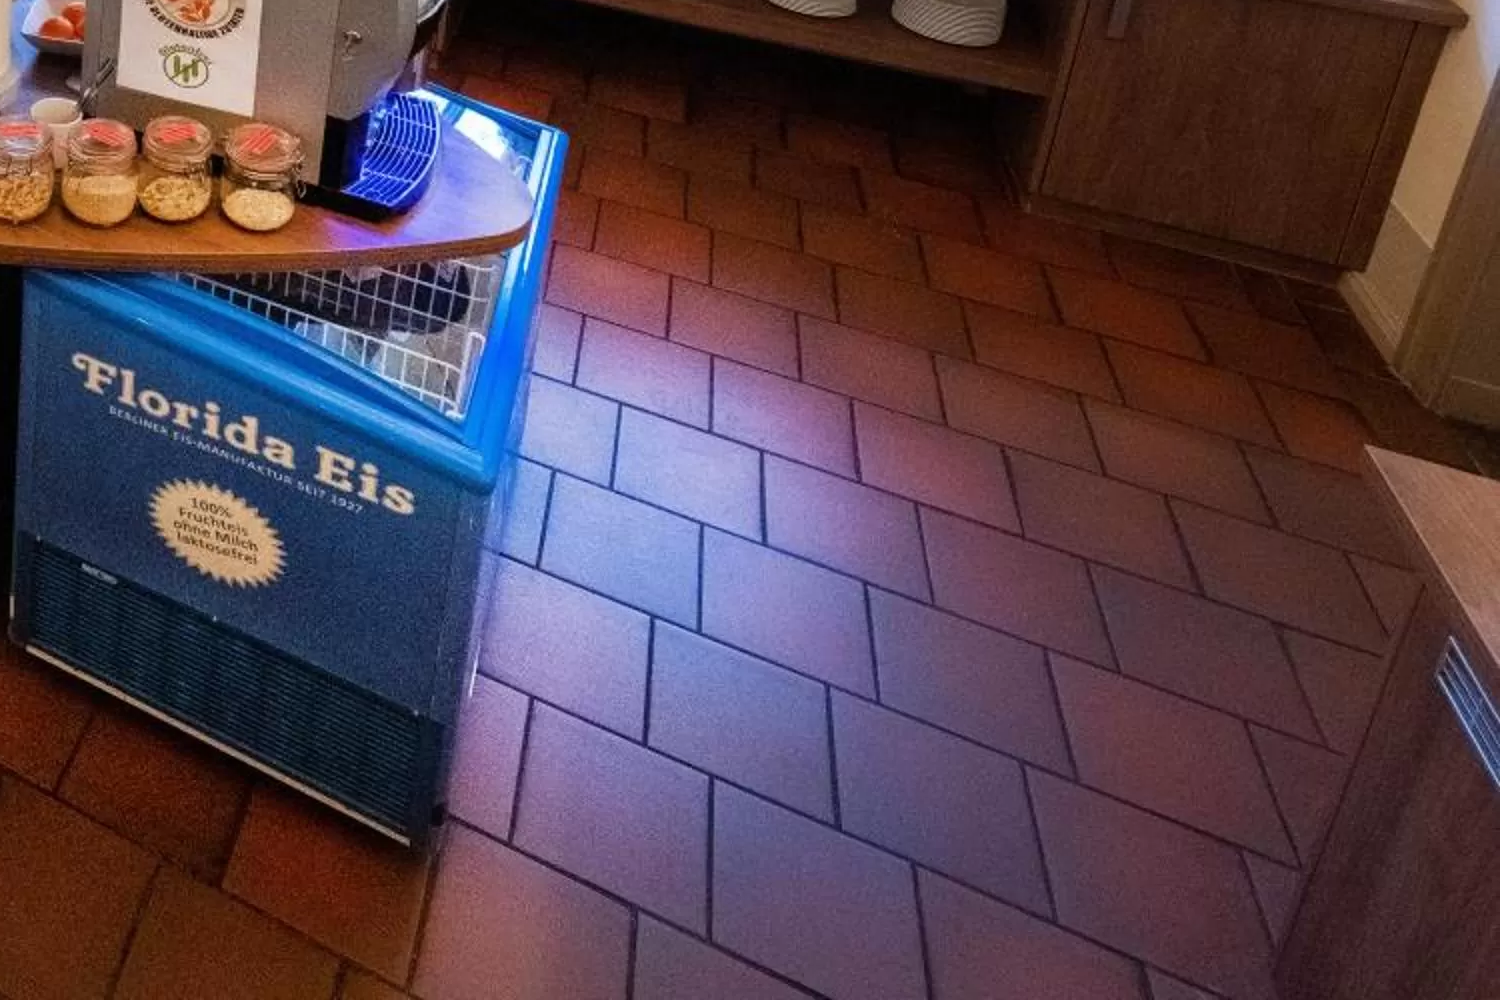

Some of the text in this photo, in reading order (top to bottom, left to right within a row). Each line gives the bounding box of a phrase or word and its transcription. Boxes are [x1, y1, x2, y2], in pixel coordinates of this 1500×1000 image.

[71, 352, 415, 515] Florida Eis
[108, 405, 169, 435] BERLINER
[297, 480, 326, 499] SEIT
[173, 519, 259, 552] ohne Milch
[188, 497, 233, 518] 100%
